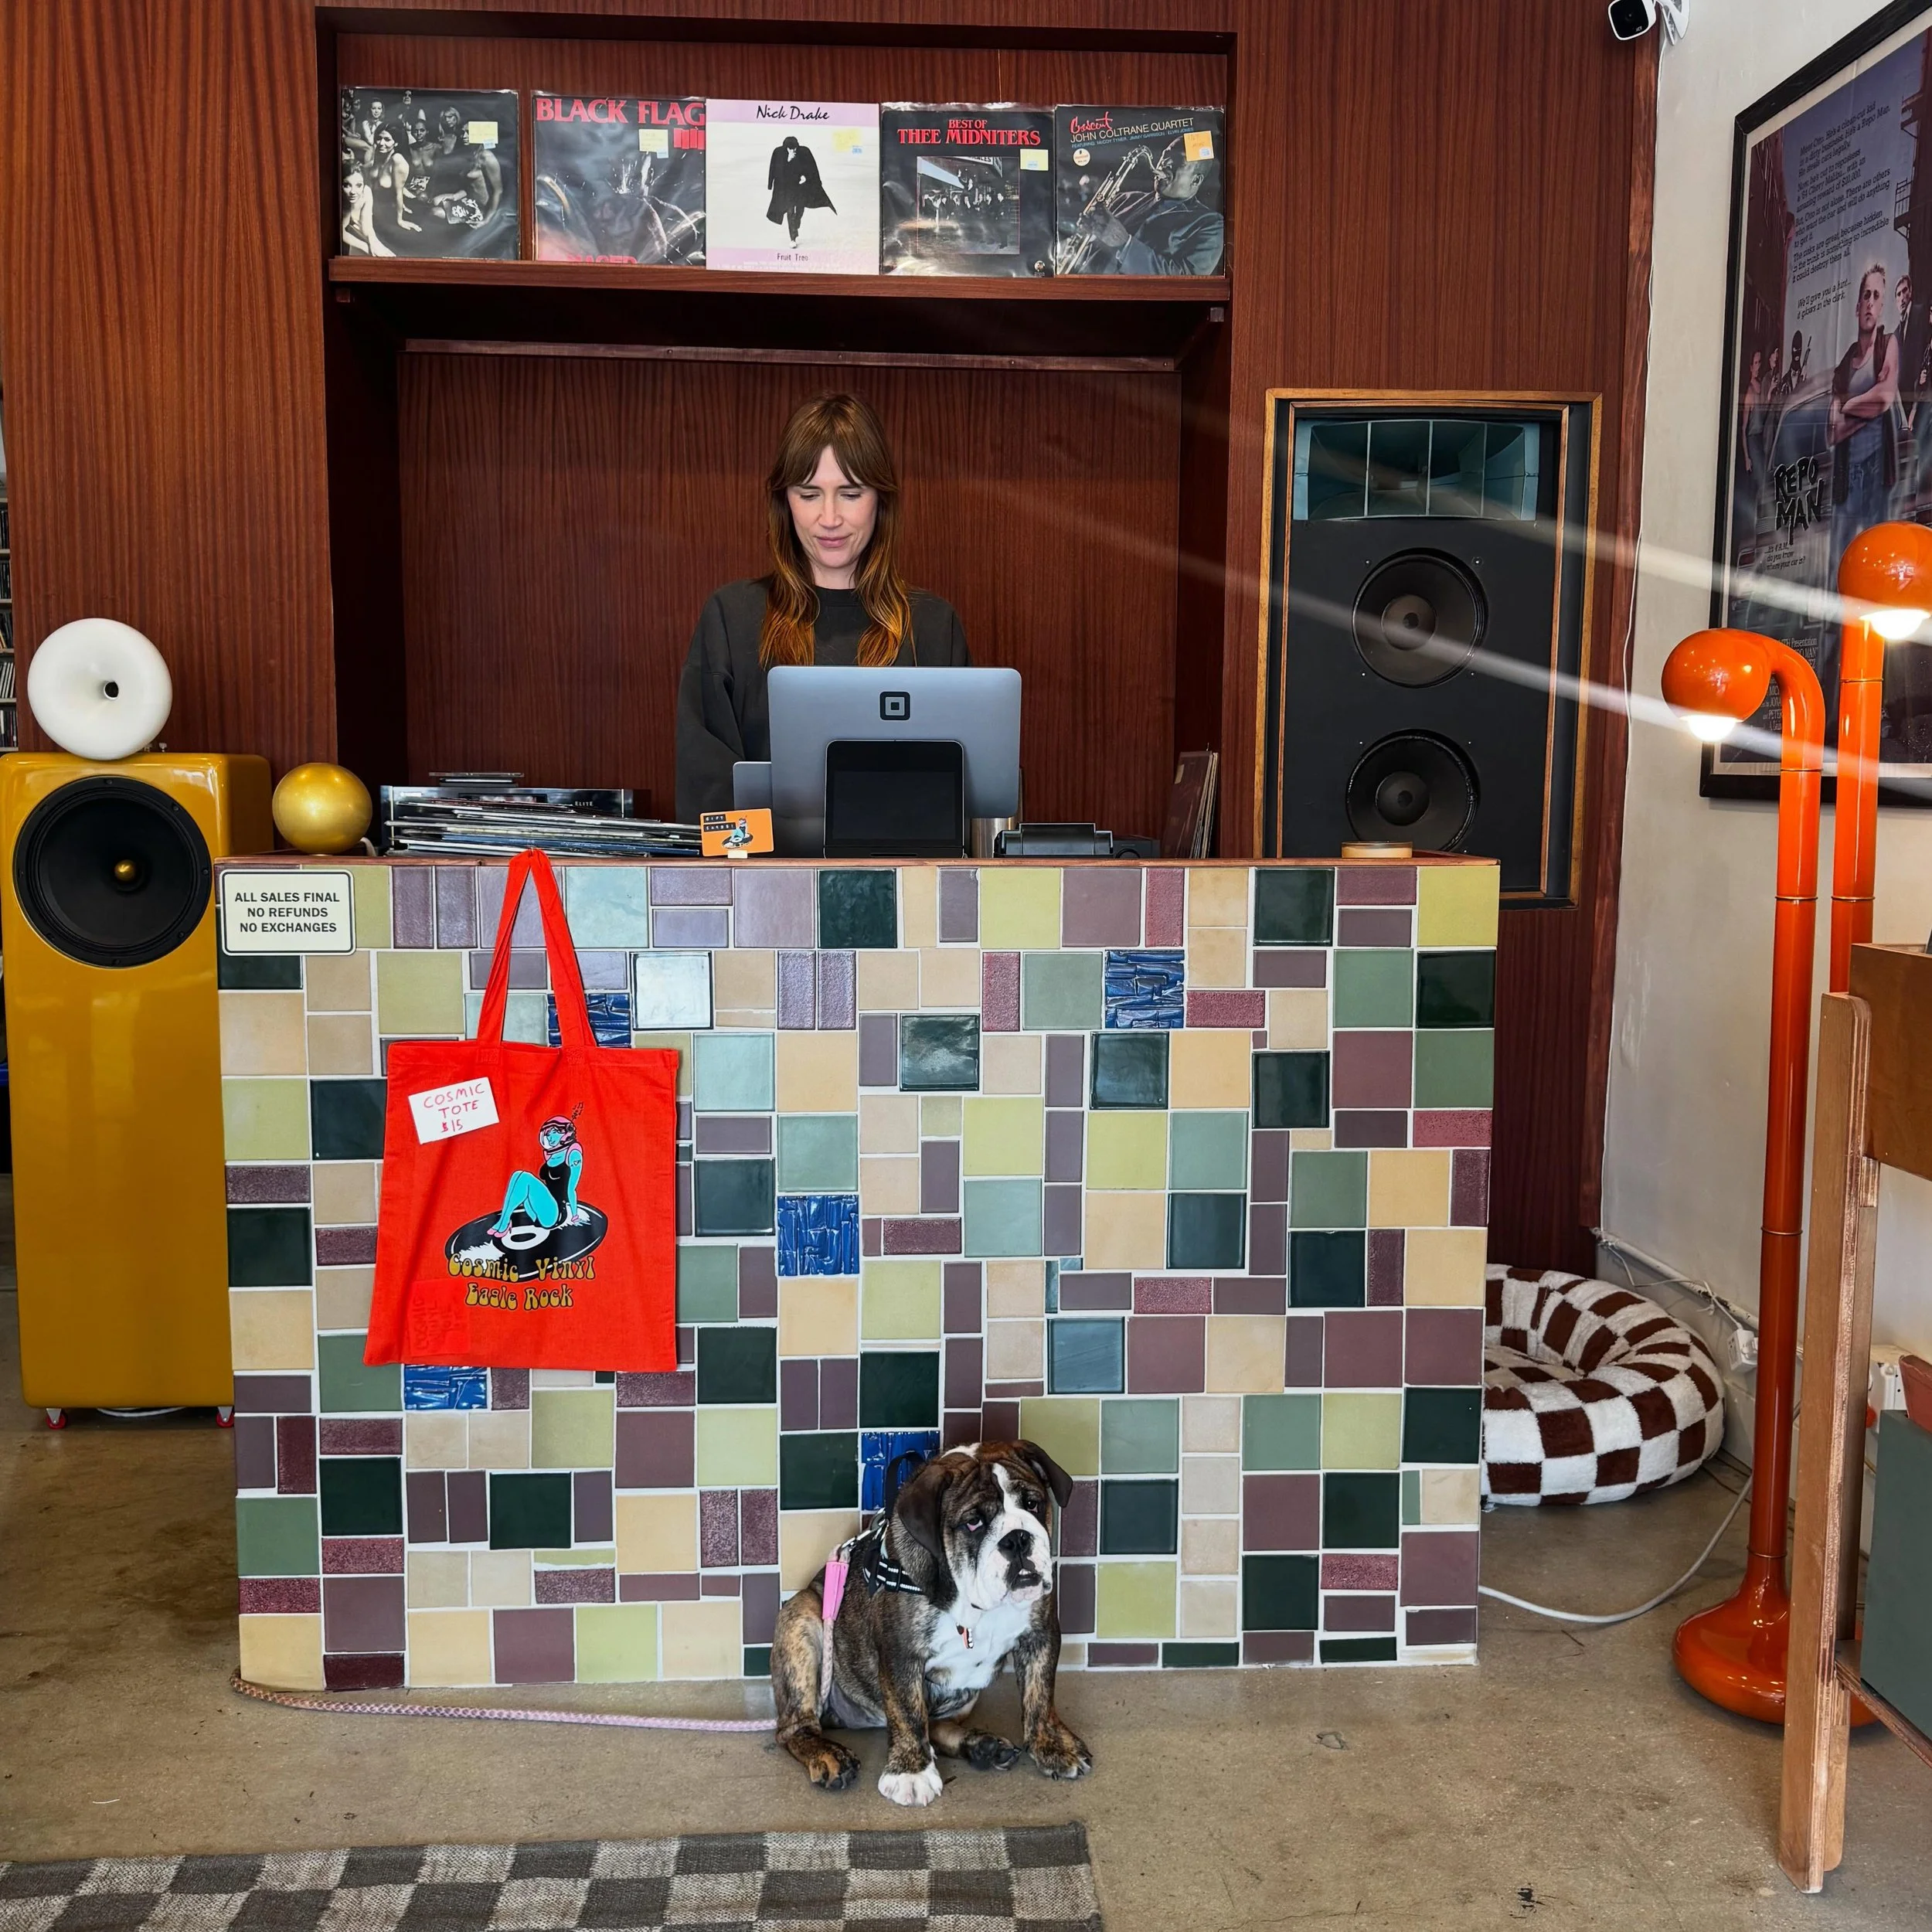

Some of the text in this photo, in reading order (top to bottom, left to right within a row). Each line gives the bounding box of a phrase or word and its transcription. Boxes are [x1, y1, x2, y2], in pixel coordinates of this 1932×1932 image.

[536, 98, 705, 126] BLACK FLAG
[757, 104, 829, 121] Nick Drake
[949, 119, 988, 129] BEST OF
[1070, 117, 1194, 144] JOHN COLTRANE QUARTET
[897, 129, 1041, 146] THEE MIDNITERS
[1817, 184, 1835, 201] reward
[1845, 185, 1862, 199] There
[1862, 179, 1872, 189] are
[1872, 168, 1890, 184] others
[1818, 215, 1827, 225] the
[1827, 209, 1836, 220] car
[1837, 202, 1846, 214] and
[1847, 196, 1857, 208] will
[1858, 193, 1865, 202] do
[1866, 179, 1890, 198] anything
[1794, 251, 1803, 263] The
[1816, 240, 1825, 251] are
[1841, 221, 1863, 238] because
[1863, 210, 1883, 226] hidden
[1798, 260, 1807, 270] the
[1807, 252, 1820, 266] trunk
[1826, 237, 1852, 257] something
[1853, 233, 1860, 242] so
[1861, 217, 1889, 239] incredible
[777, 253, 791, 261] Fruit
[1796, 267, 1810, 281] could
[1810, 258, 1829, 274] destroy
[1829, 253, 1842, 264] them
[1810, 292, 1821, 307] give
[1822, 287, 1832, 300] you
[1823, 298, 1832, 308] the
[1774, 455, 1818, 503] REPO
[1775, 478, 1825, 546] MAN
[234, 892, 340, 902] ALL SALES FINAL
[247, 907, 328, 917] NO REFUNDS
[240, 922, 337, 932] NO EXCHANGES
[423, 1083, 485, 1108] COSMIC
[438, 1100, 479, 1118] TOTE
[441, 1119, 464, 1133] $15
[447, 1253, 596, 1282] Cosmic Vinyl
[465, 1282, 573, 1311] Eagle Rock
